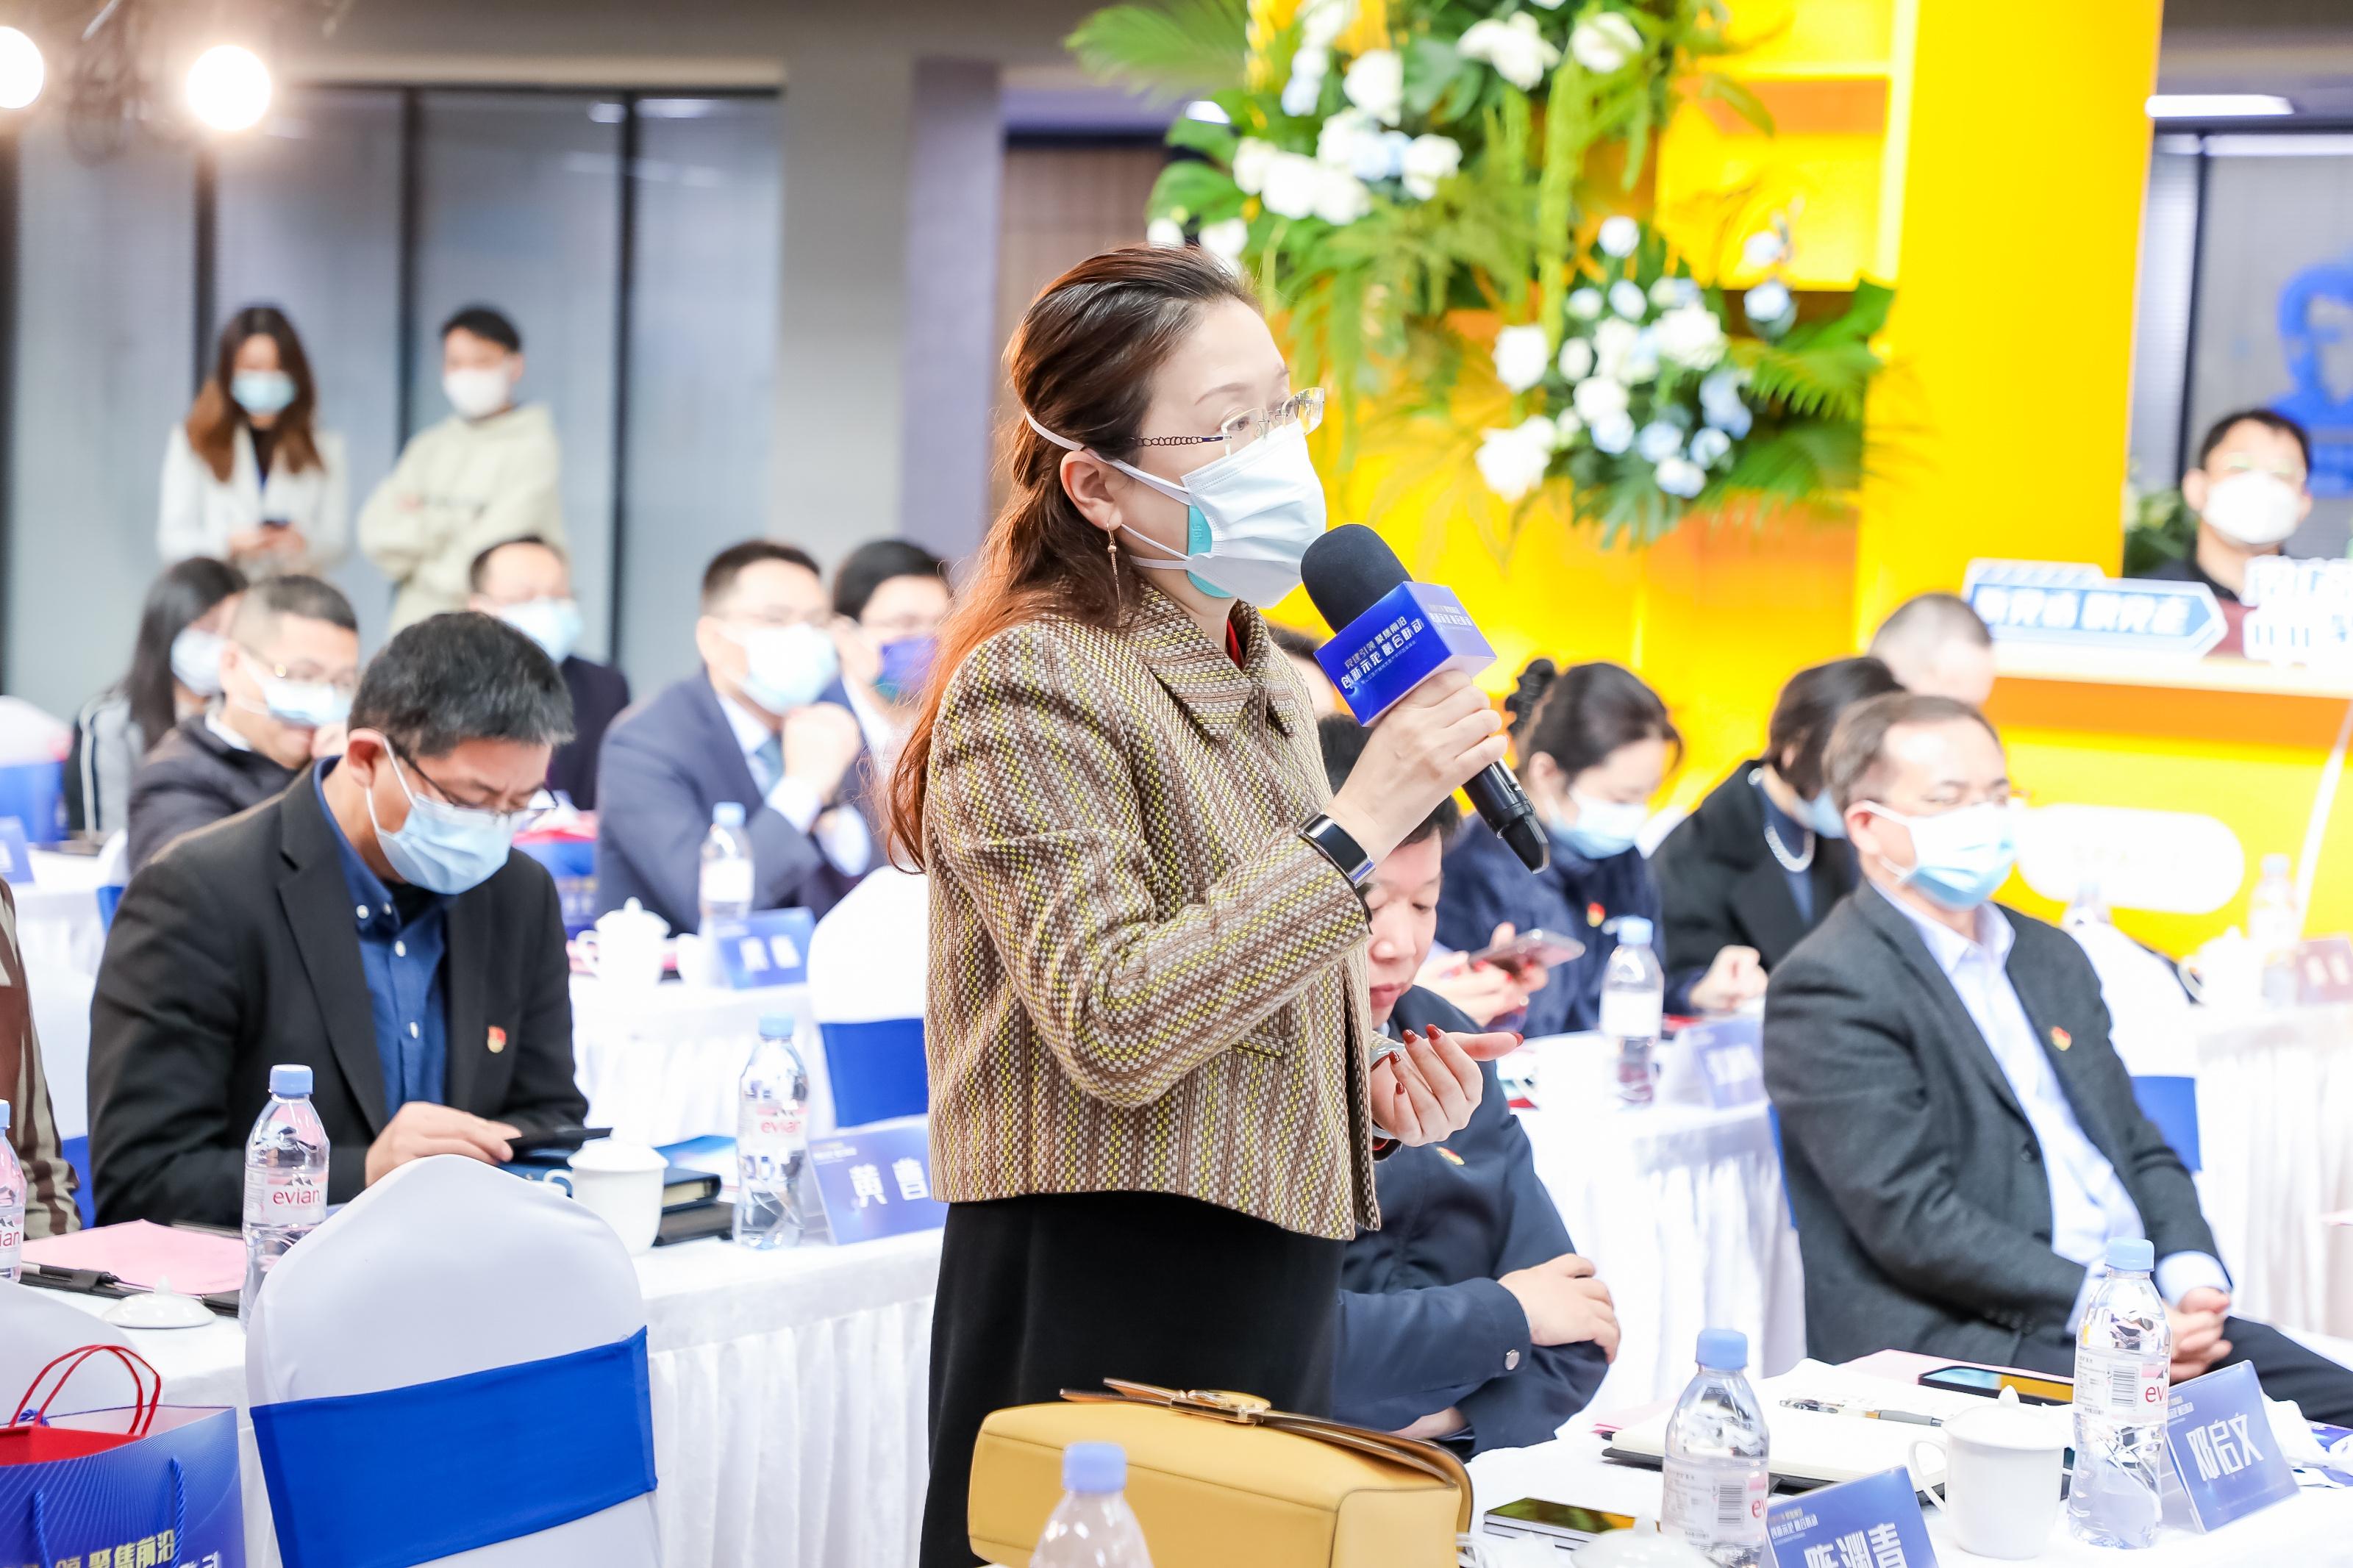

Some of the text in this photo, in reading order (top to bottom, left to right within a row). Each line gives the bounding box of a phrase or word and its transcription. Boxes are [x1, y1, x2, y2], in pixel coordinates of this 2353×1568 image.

[1340, 651, 1382, 690] 创新示范
[1381, 618, 1425, 657] 融合联动
[273, 1187, 321, 1205] evian
